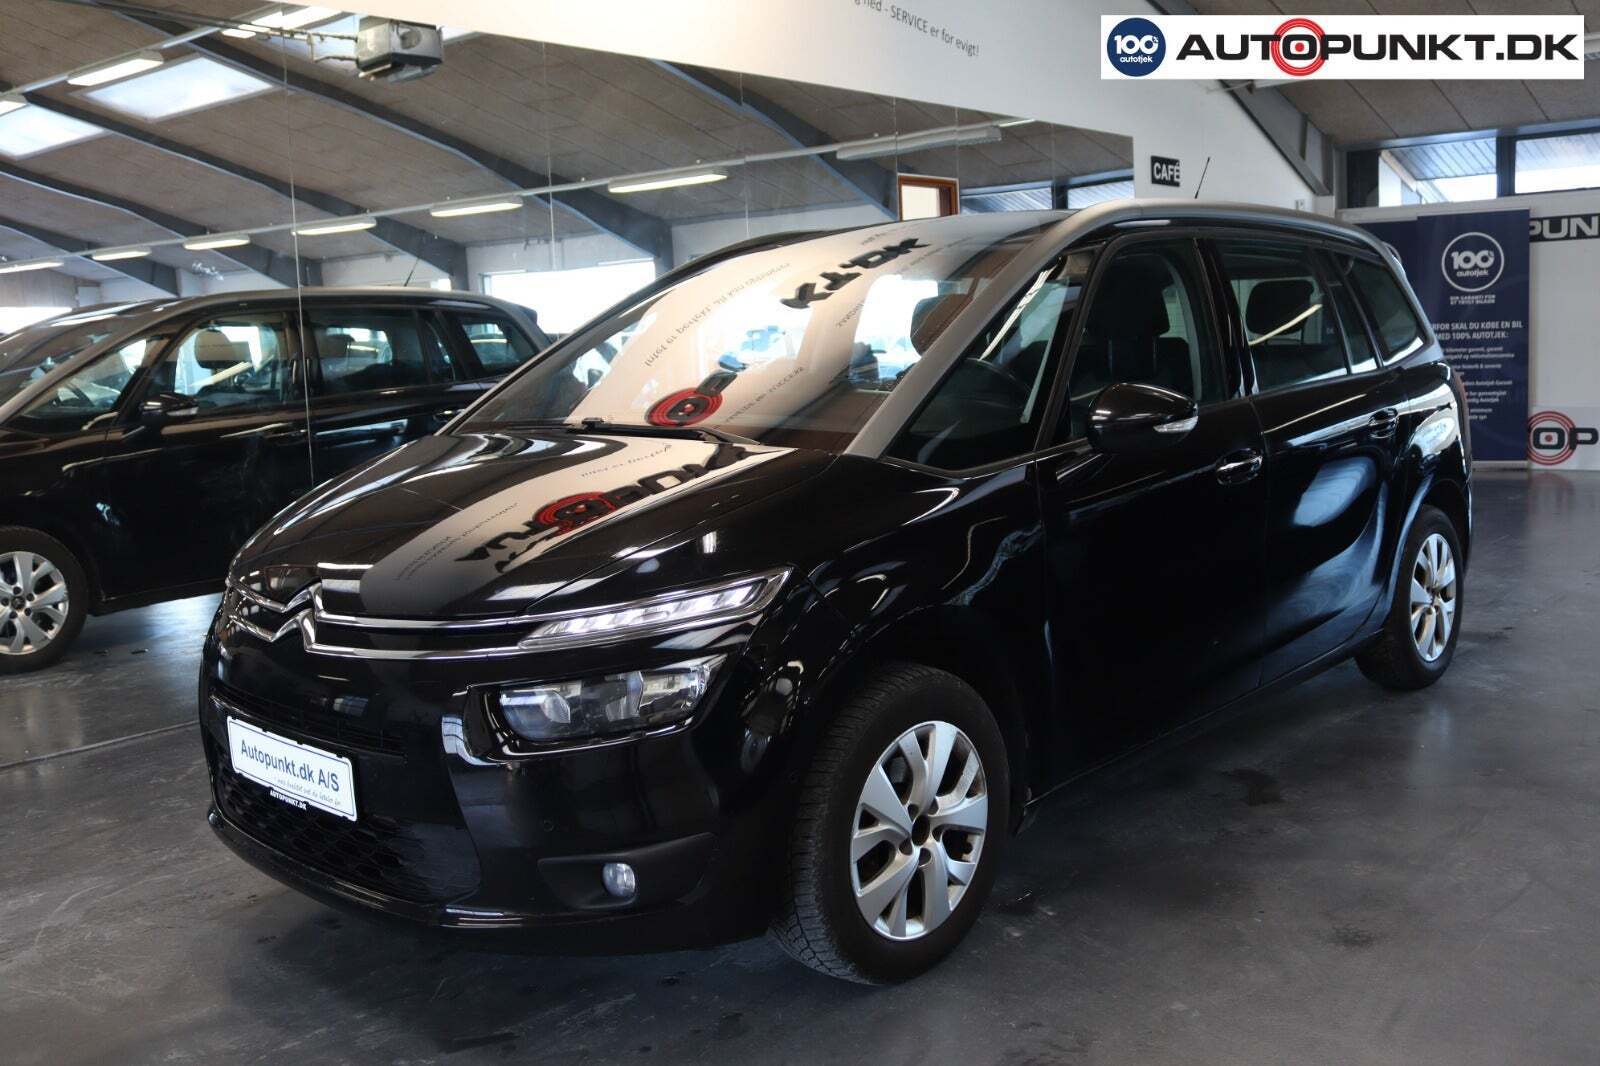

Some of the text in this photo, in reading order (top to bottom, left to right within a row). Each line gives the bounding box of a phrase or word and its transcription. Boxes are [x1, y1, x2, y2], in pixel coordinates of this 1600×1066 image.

[890, 5, 929, 33] SERVICE
[930, 26, 939, 37] er
[941, 28, 954, 45] for
[955, 39, 980, 57] evigt!
[1154, 156, 1180, 182] CAFÉ
[1451, 322, 1468, 330] SKAL
[1469, 321, 1480, 330] DU
[1500, 320, 1510, 329] EN
[1511, 319, 1523, 329] BIL
[241, 739, 315, 783] Autopunkt.dk
[318, 769, 340, 792] A/S
